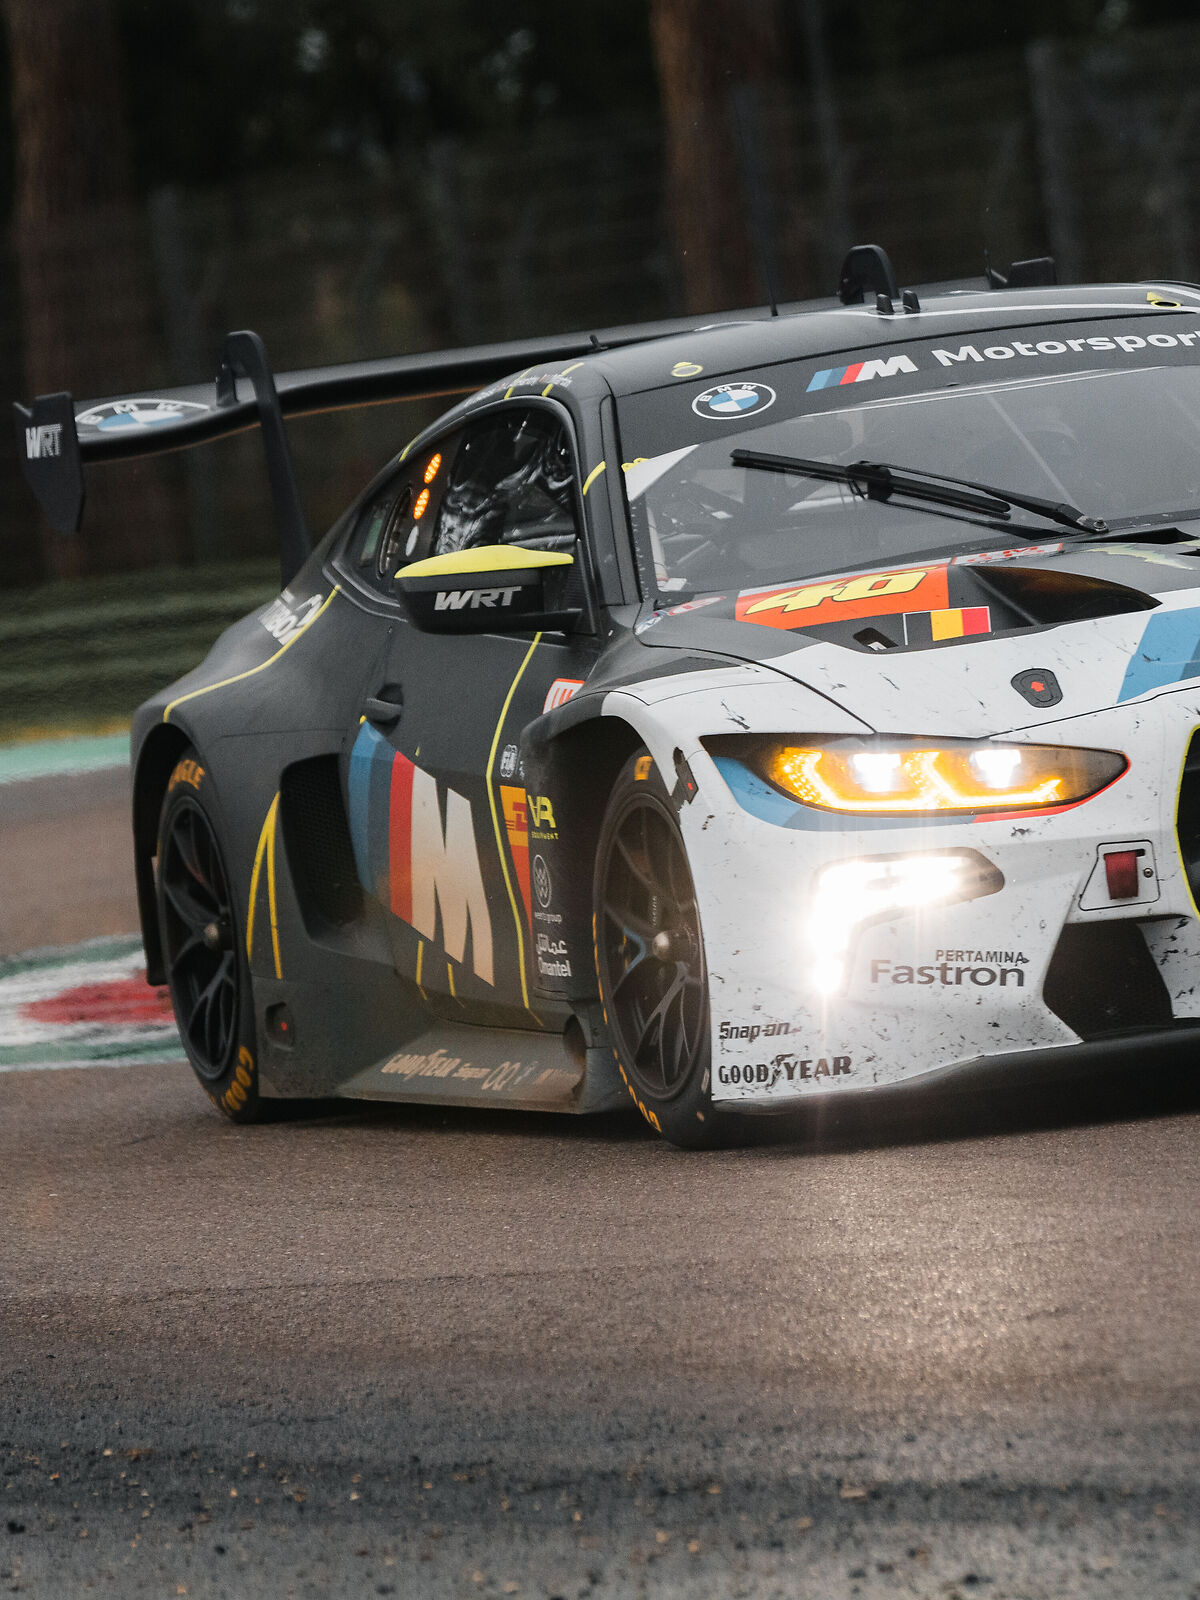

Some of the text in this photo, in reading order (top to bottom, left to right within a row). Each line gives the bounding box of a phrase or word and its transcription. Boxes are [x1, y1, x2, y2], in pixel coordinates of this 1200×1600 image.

[26, 423, 63, 459] WRT
[434, 586, 522, 611] WRT
[935, 949, 1025, 963] PERTAMINA
[870, 959, 1025, 987] Fastron
[719, 1021, 792, 1042] Snap-on
